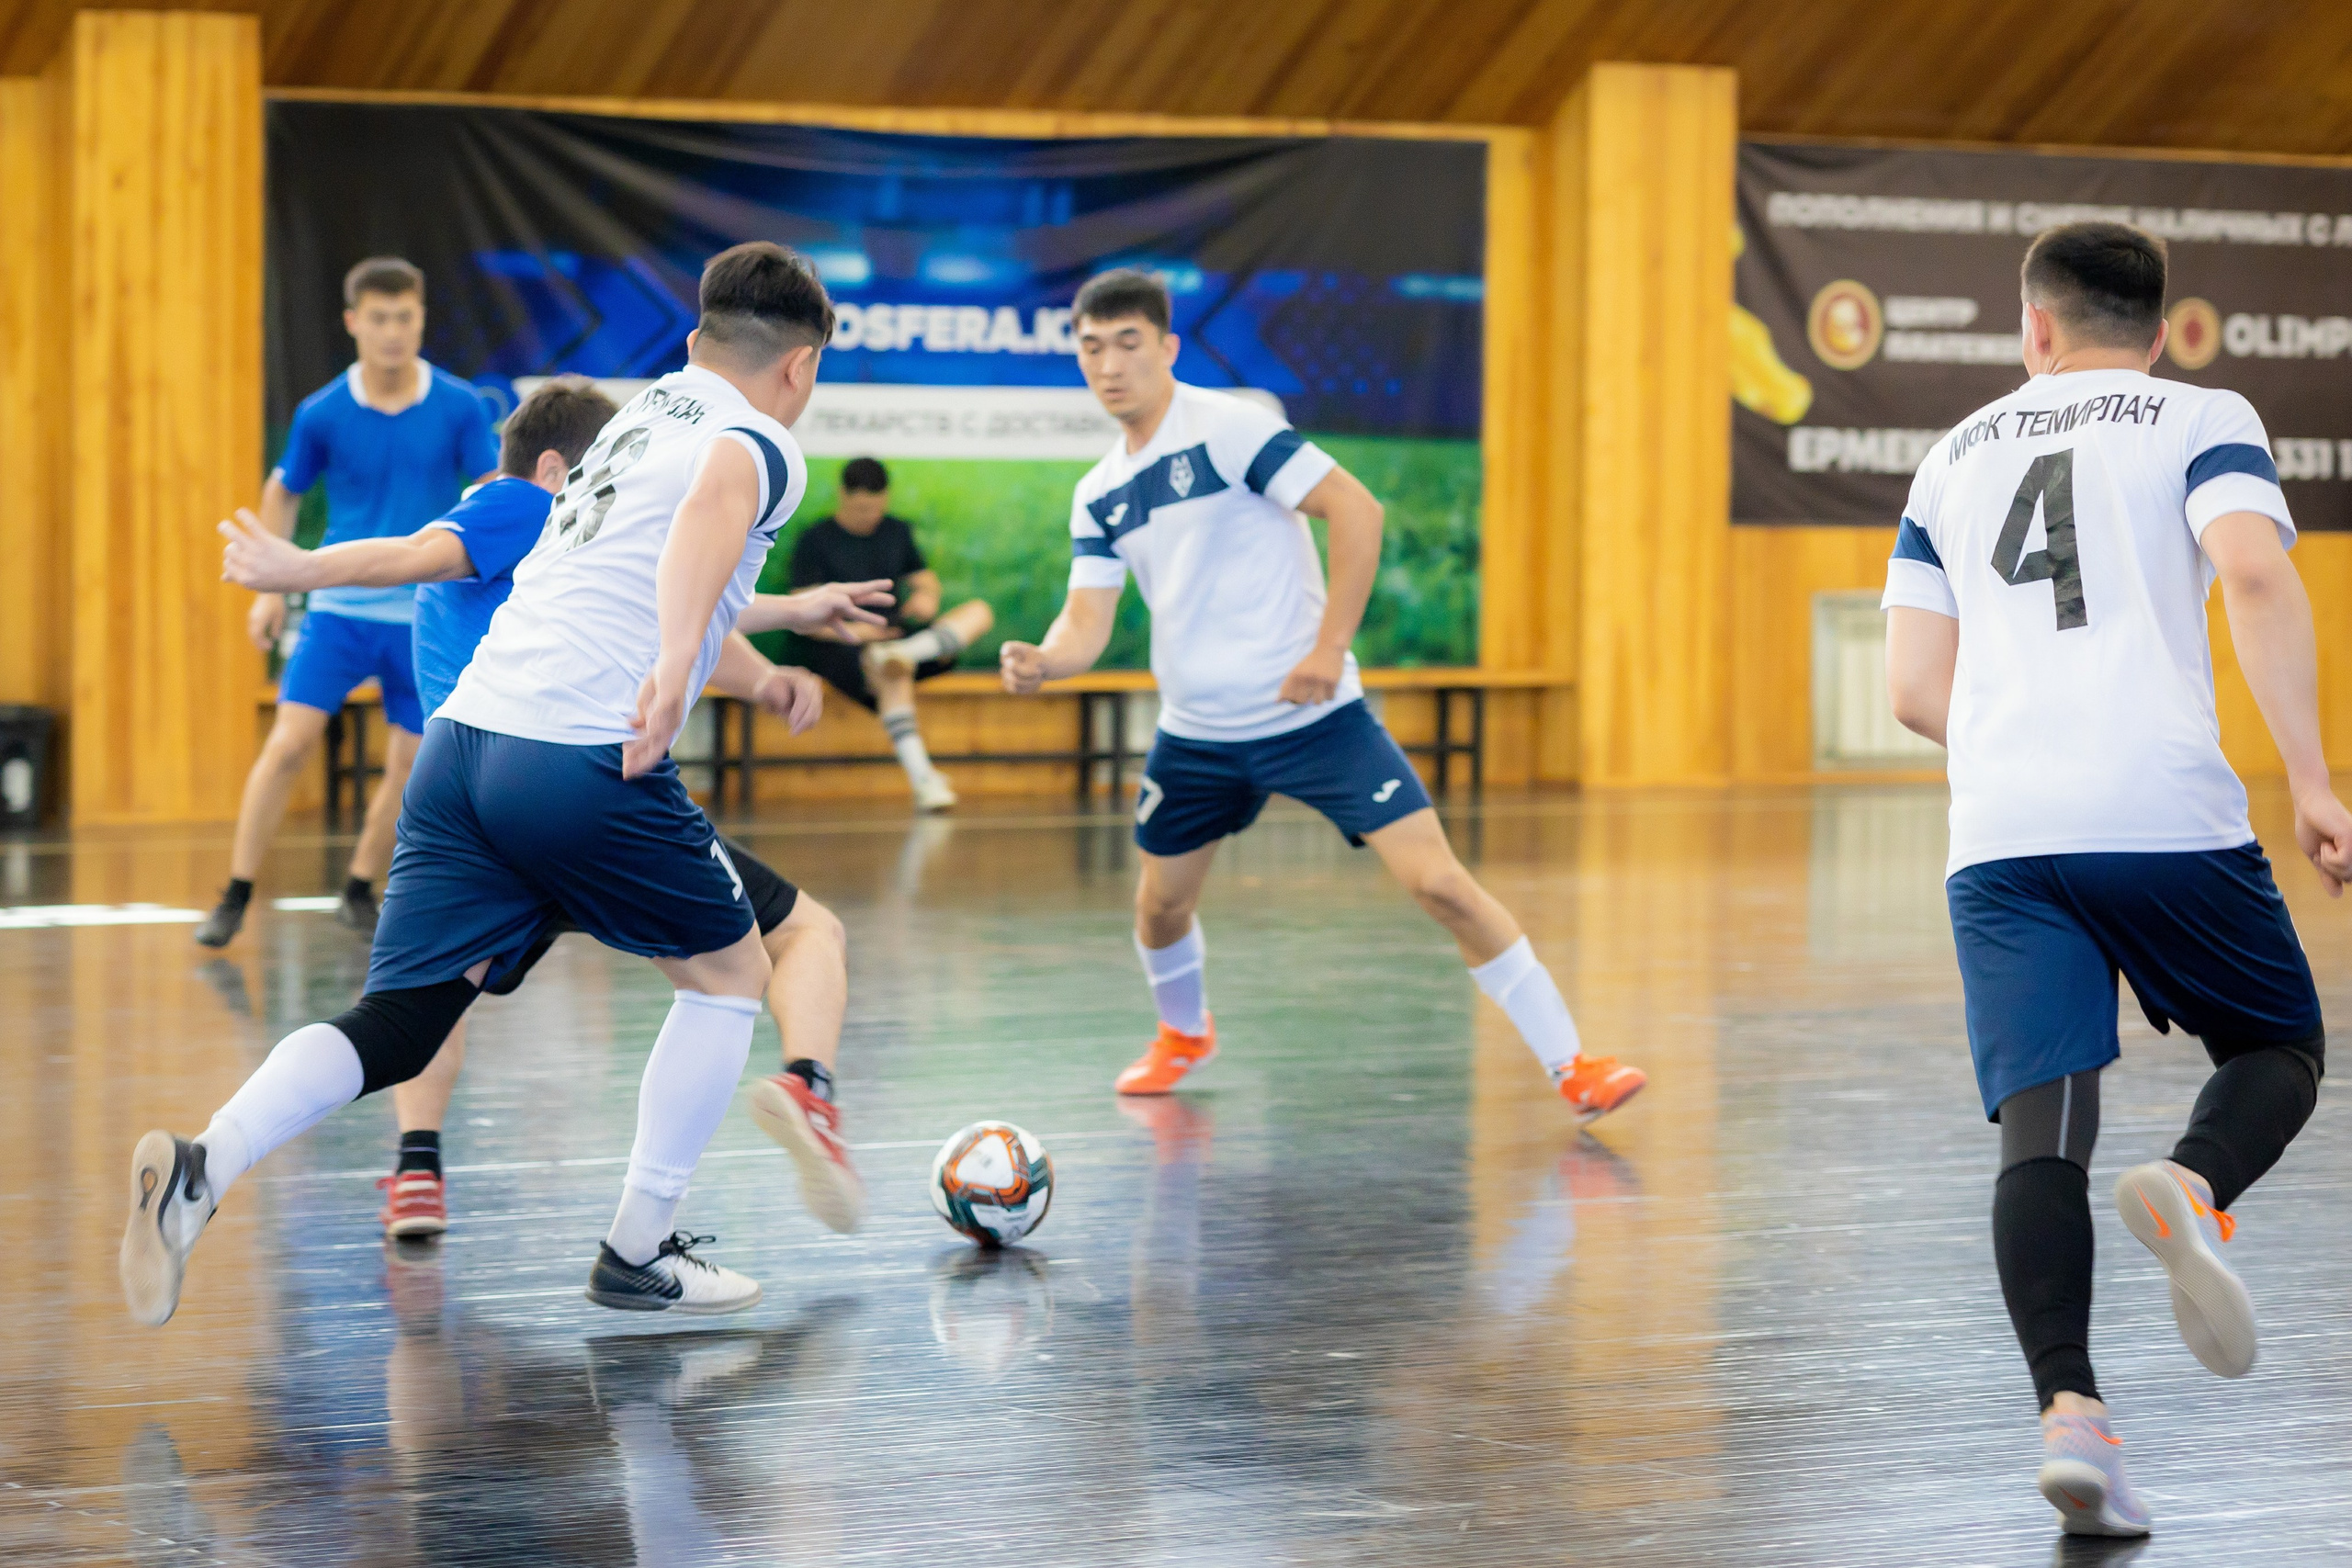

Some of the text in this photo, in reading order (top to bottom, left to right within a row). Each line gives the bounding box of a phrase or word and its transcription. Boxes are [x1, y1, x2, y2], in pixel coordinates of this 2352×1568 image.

[831, 302, 1077, 355] OSFERA.K
[2223, 313, 2352, 358] OLIMP
[1948, 394, 2166, 466] МФК ТЕМИРЛАН
[1990, 447, 2088, 631] 4
